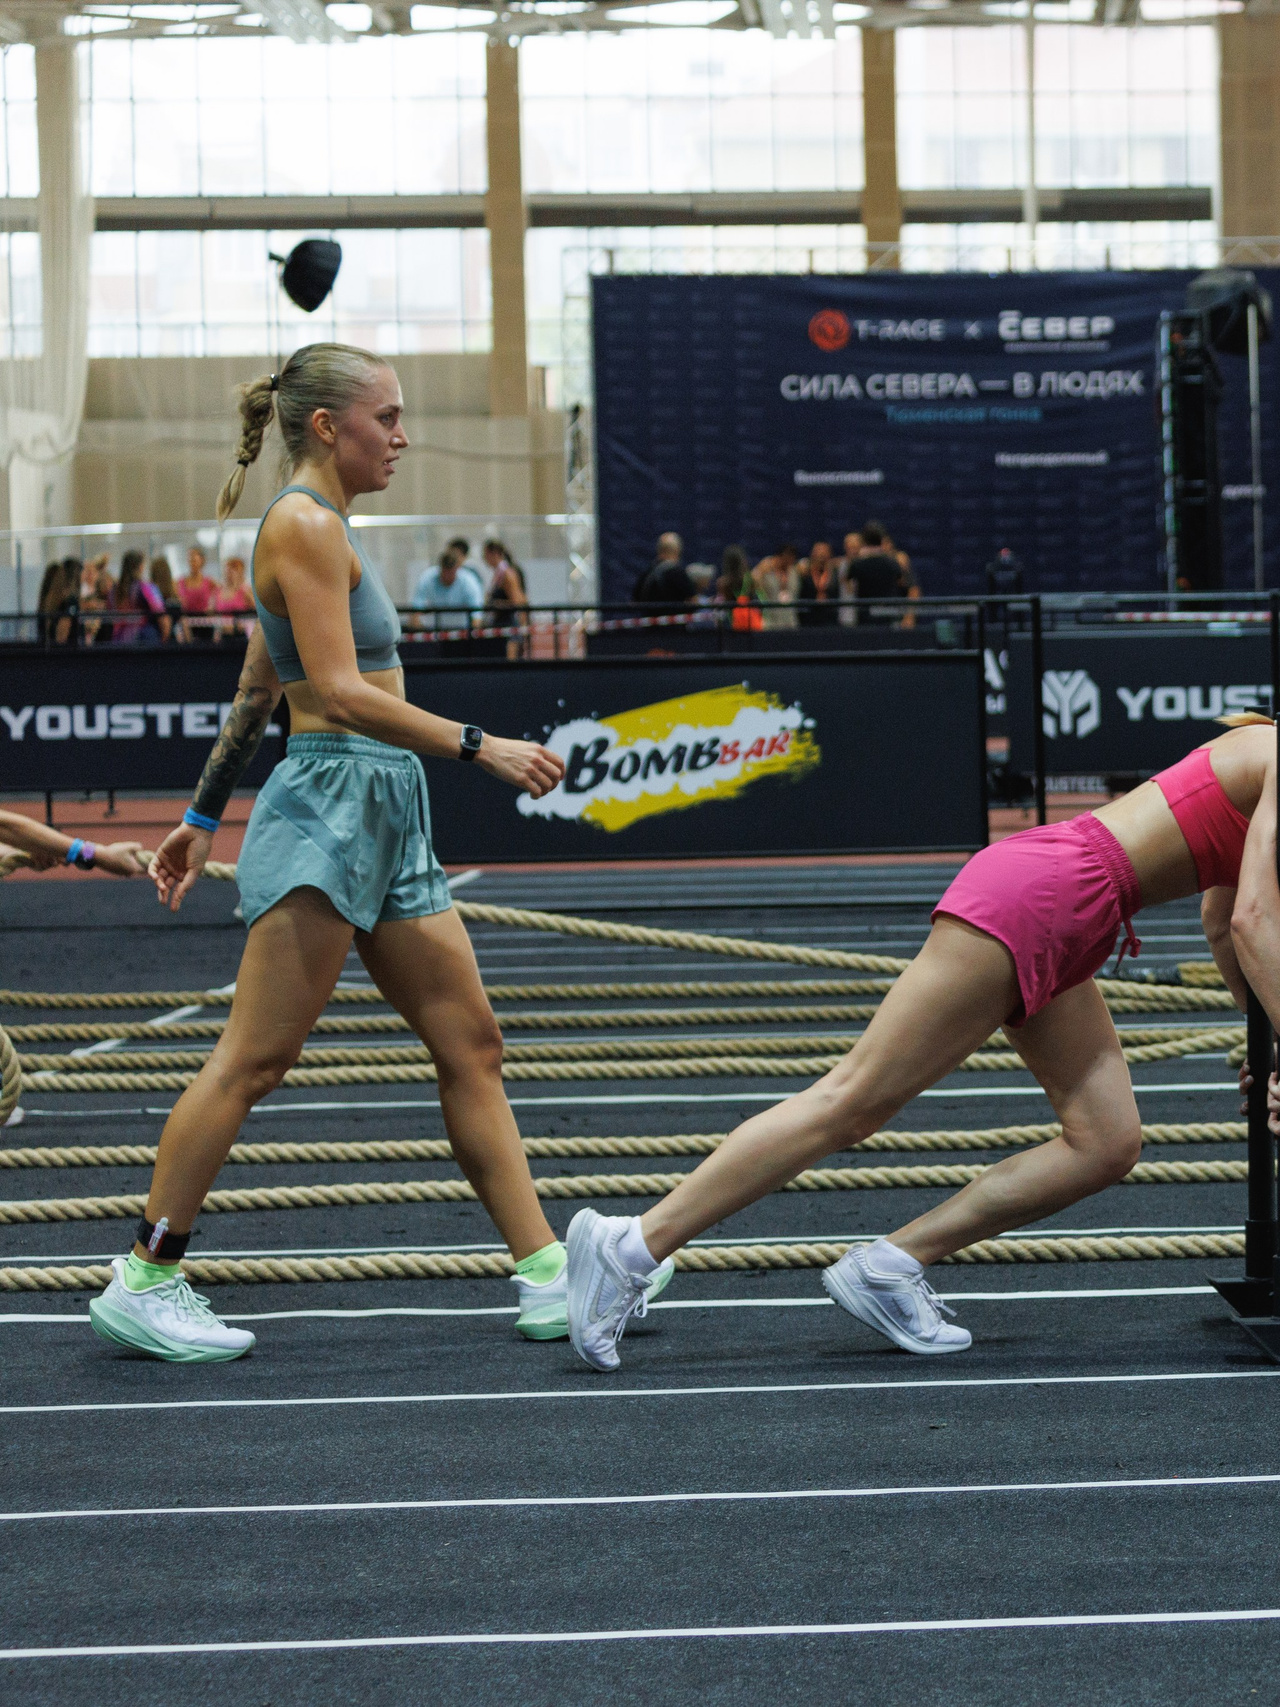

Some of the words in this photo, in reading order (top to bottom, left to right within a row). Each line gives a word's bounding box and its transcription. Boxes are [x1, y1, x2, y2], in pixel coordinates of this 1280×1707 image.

[780, 374, 864, 400] СИЛА
[865, 373, 978, 400] СЕВЕРА
[1012, 372, 1035, 398] В
[1036, 370, 1145, 399] ЛЮДЯХ
